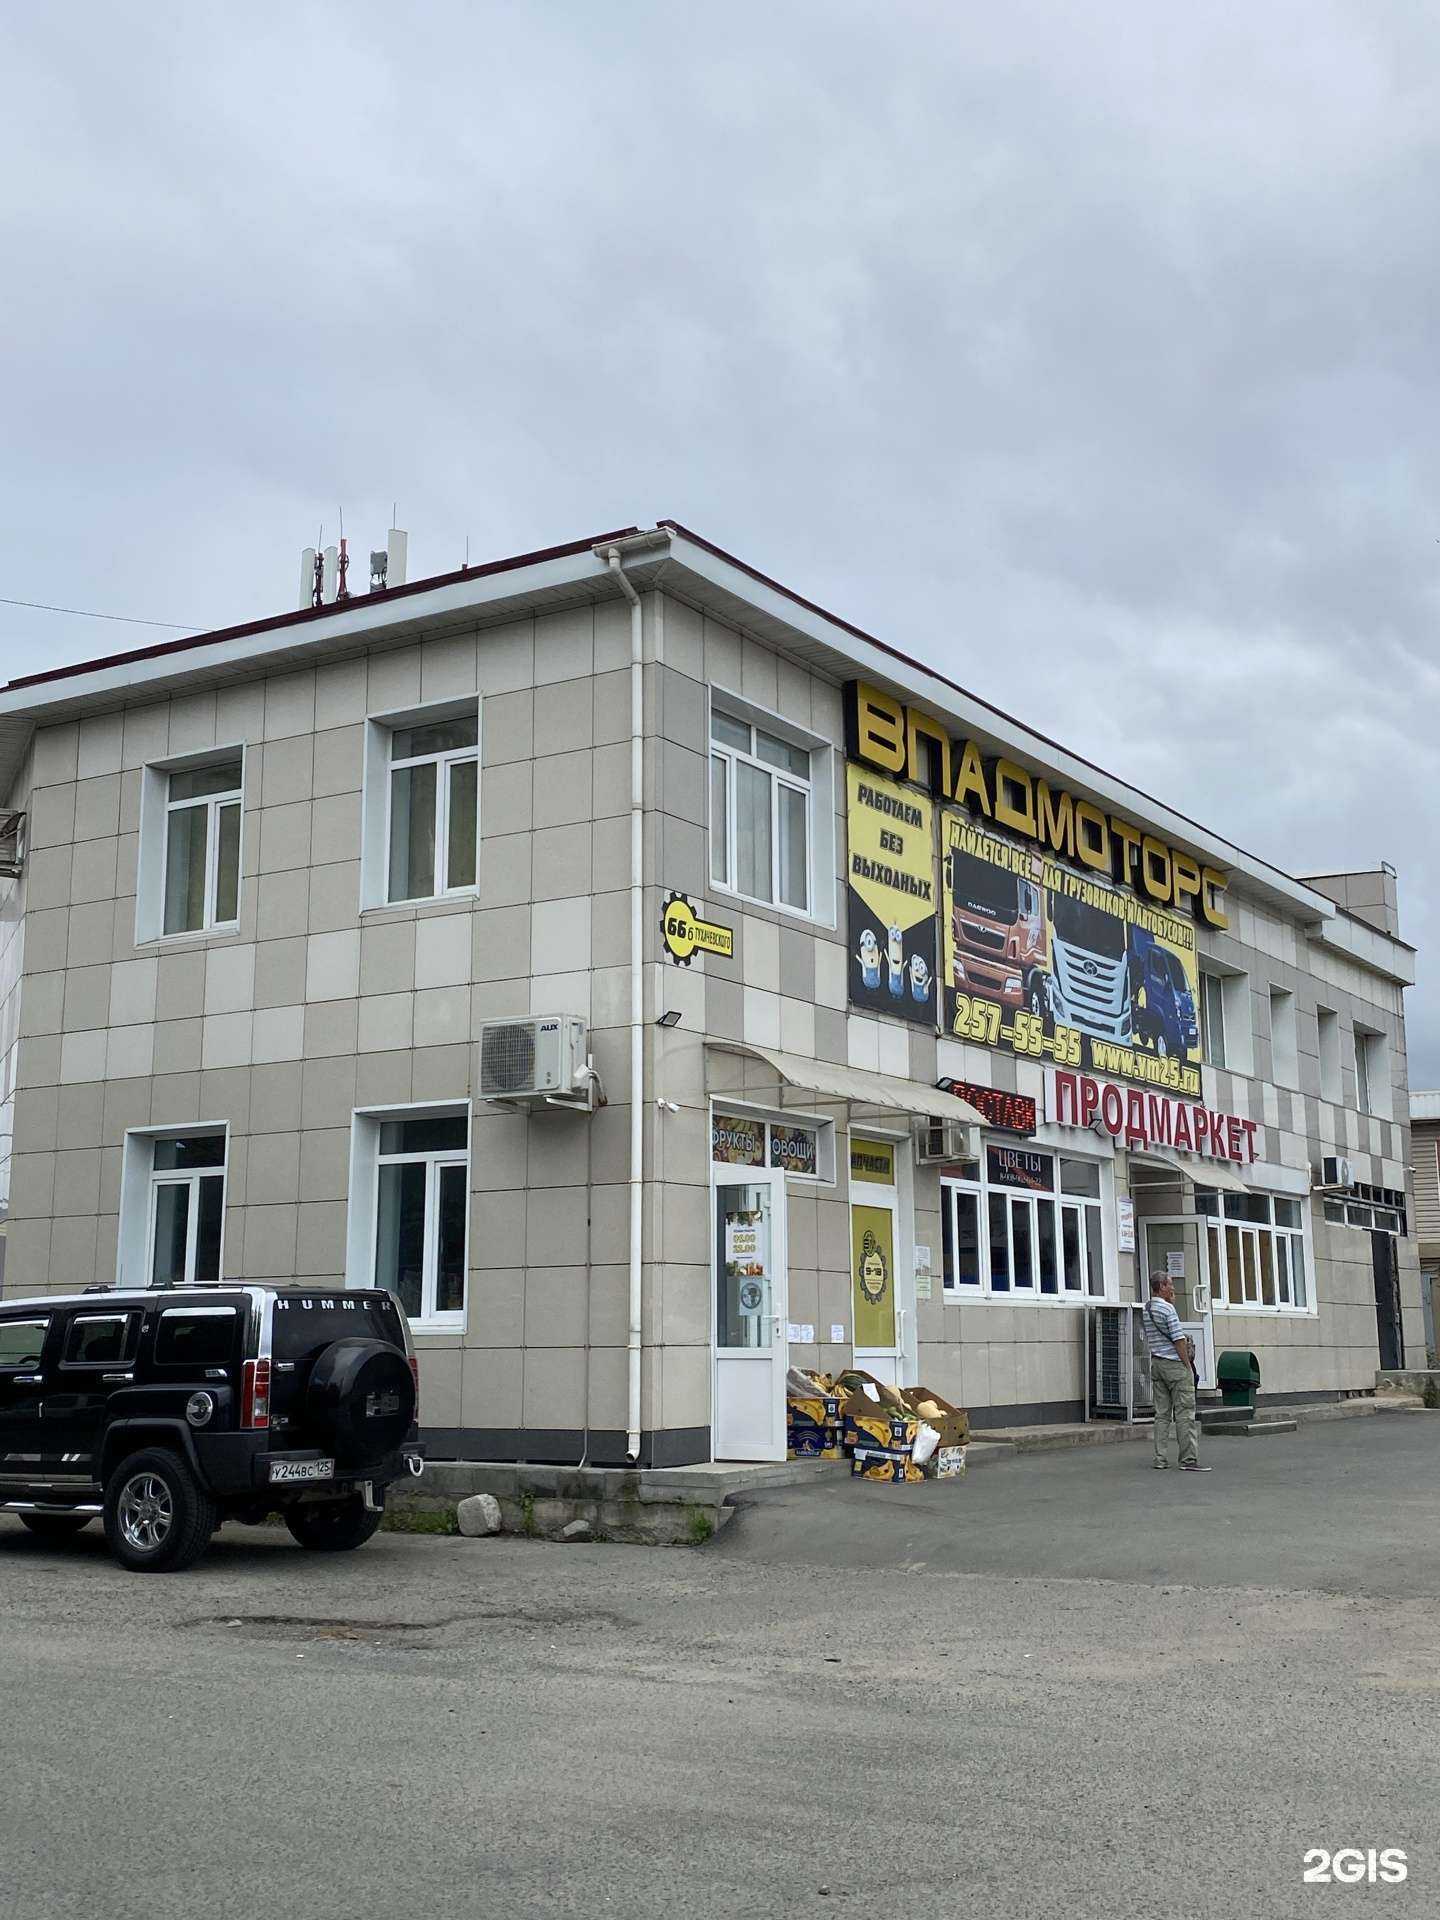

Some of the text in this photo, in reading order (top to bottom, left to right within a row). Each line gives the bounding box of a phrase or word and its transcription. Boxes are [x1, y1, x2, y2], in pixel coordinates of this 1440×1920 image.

[857, 782, 923, 830] РАБОТАЕМ
[880, 828, 904, 856] БЕЗ
[852, 853, 931, 902] ВЫХОДНЫХ
[953, 992, 1082, 1068] 257-55-55
[1055, 1071, 1258, 1164] ПРОДМАРКЕТ
[712, 1128, 814, 1160] ФРУКТЫ ОВОЩИ
[998, 1149, 1042, 1172] ЦВЕТЫ
[277, 1300, 392, 1311] HUMMER
[315, 1461, 330, 1474] 125
